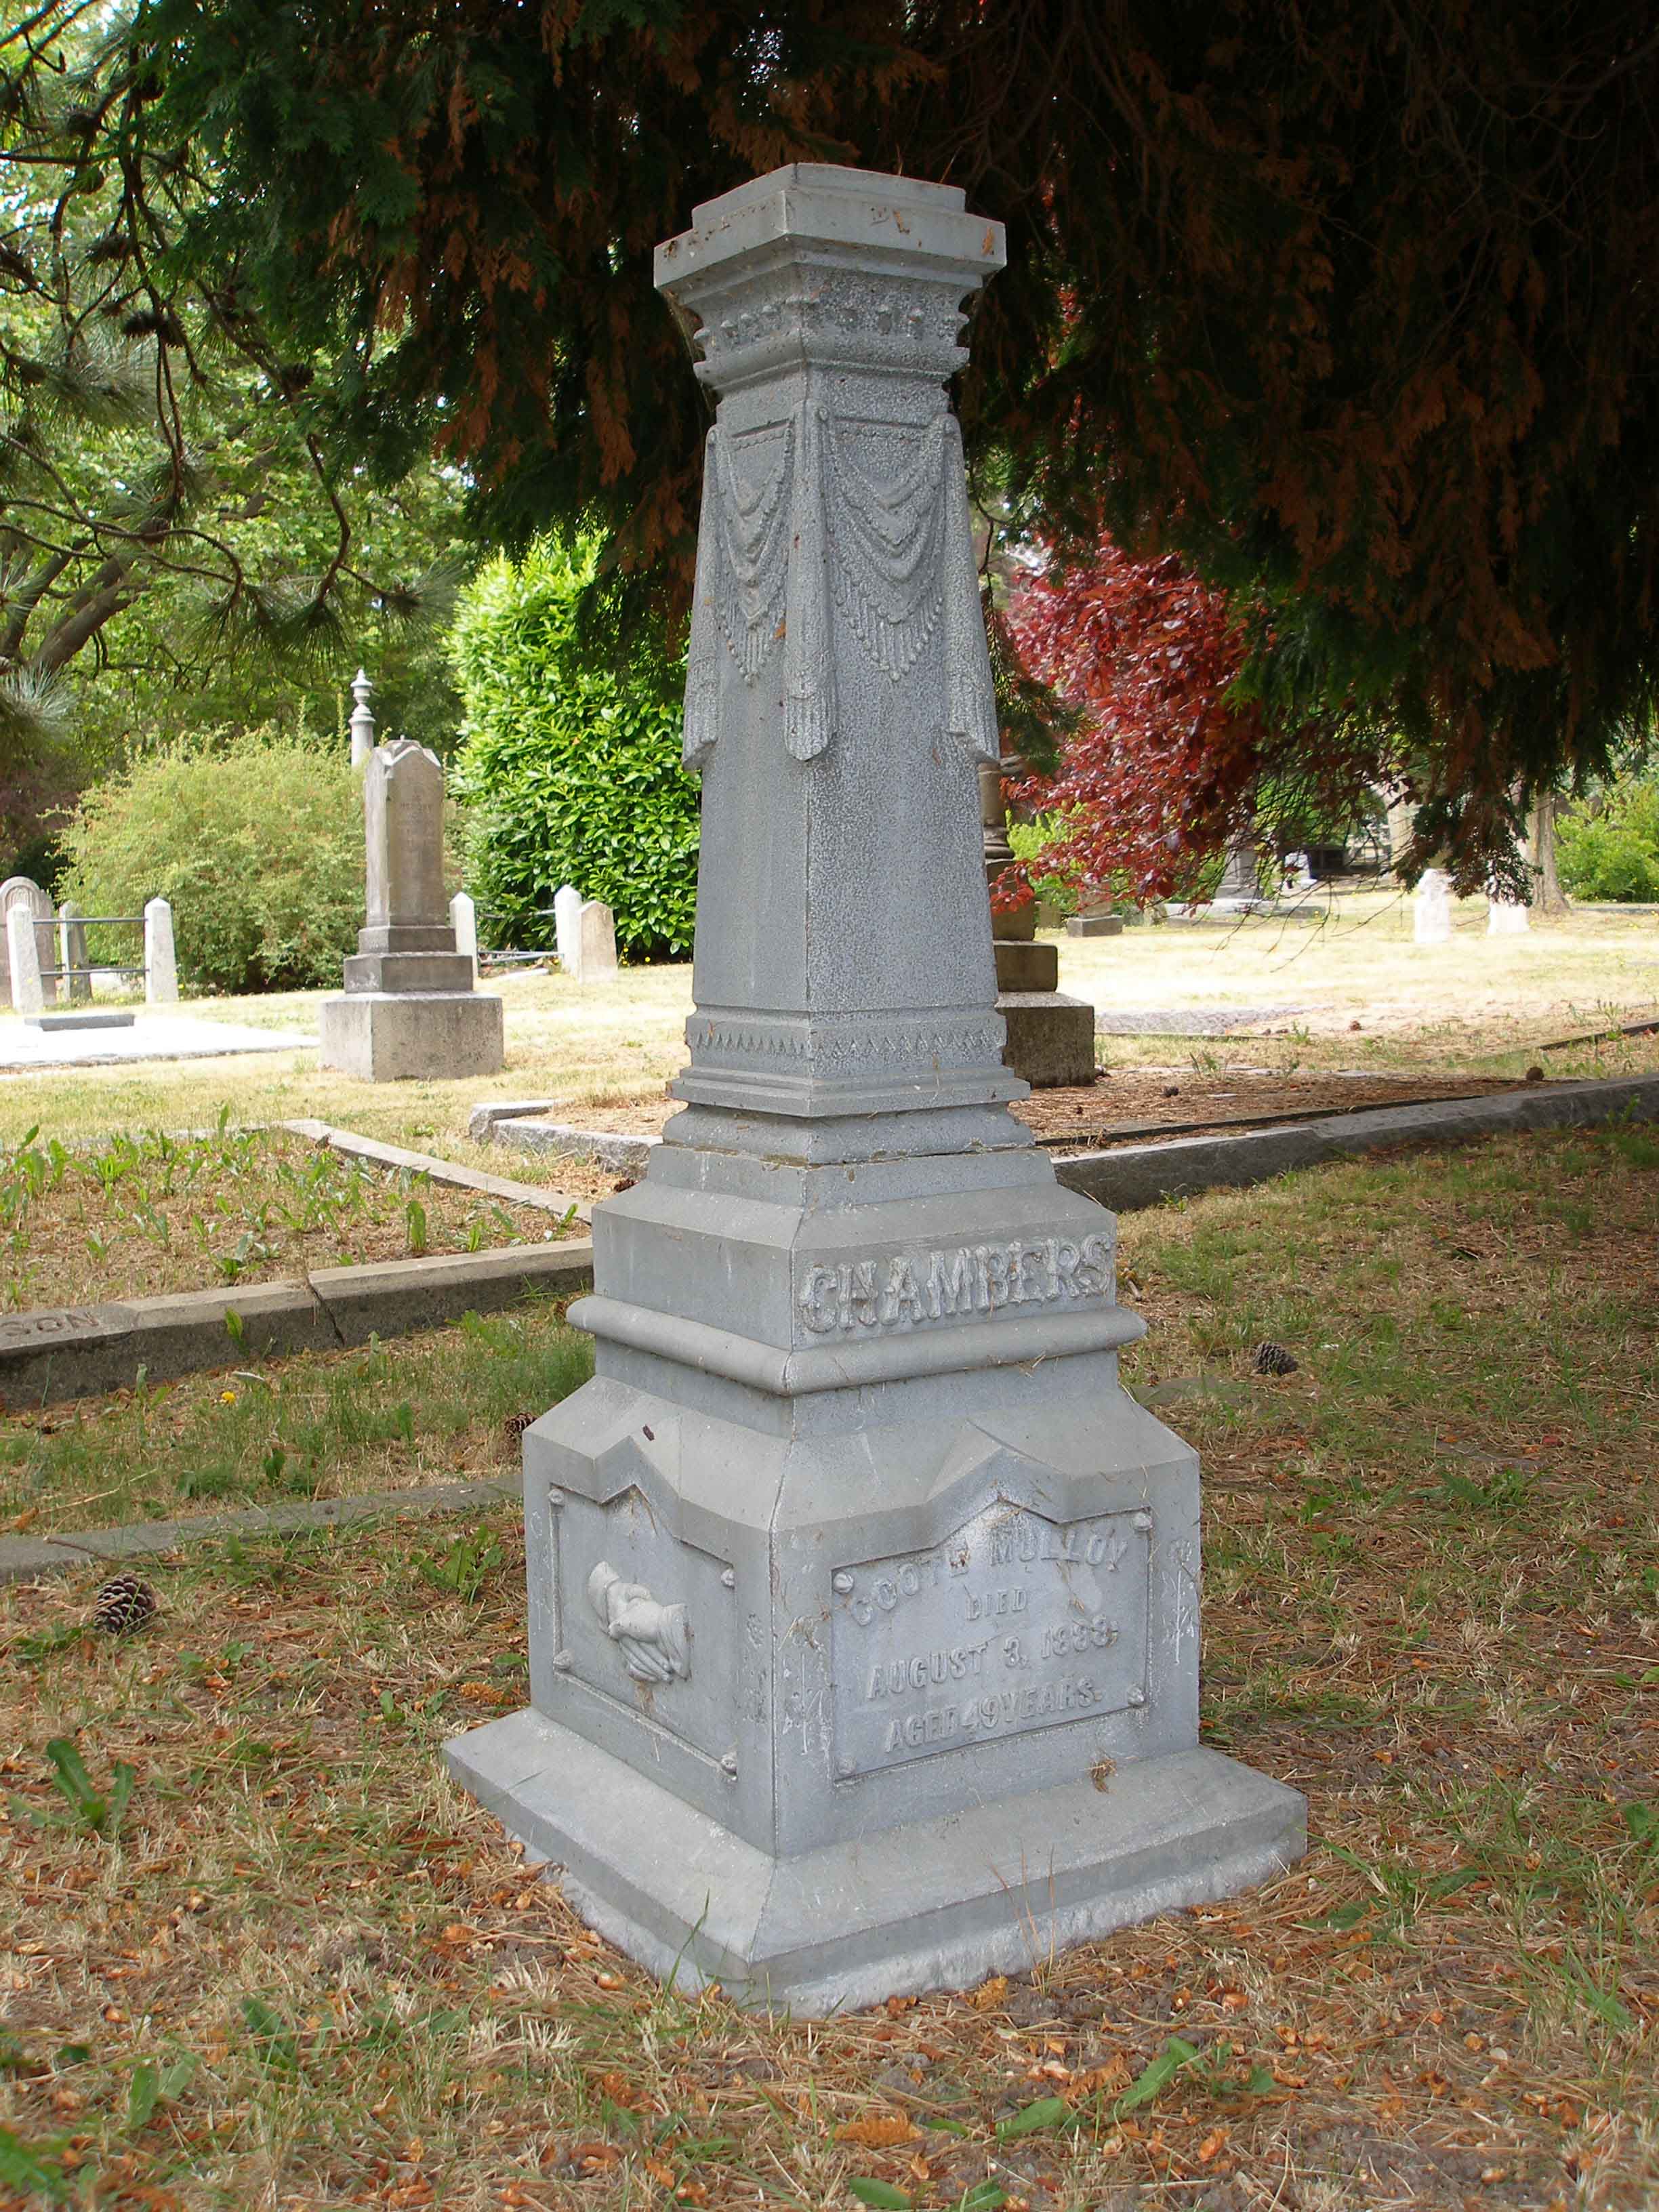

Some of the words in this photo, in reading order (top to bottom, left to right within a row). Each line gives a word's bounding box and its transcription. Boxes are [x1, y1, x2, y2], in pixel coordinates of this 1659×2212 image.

[798, 1233, 1113, 1333] CHAMBERS
[987, 1523, 1128, 1572] MULLOY
[968, 1589, 1028, 1622] DIED
[867, 1642, 989, 1700] AUGUST
[884, 1705, 957, 1754] AGED
